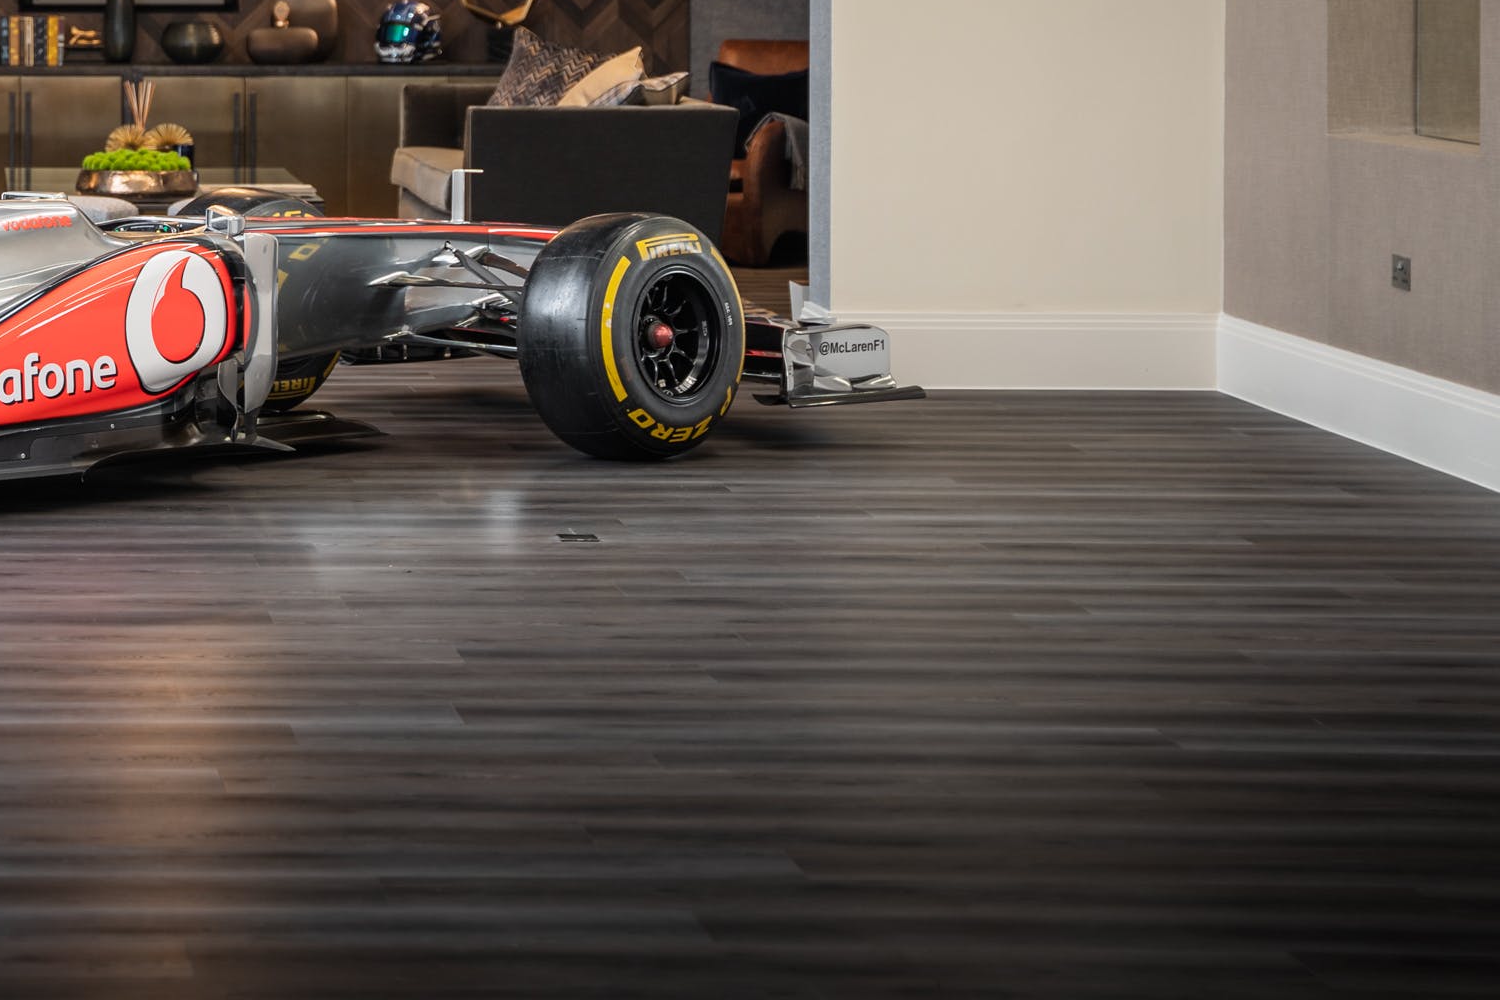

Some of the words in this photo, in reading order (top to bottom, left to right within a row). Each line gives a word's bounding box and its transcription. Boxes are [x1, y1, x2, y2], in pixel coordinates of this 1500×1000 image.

[819, 339, 885, 356] @McLarenF1
[266, 376, 317, 400] PIREL
[628, 406, 713, 443] ZERO
